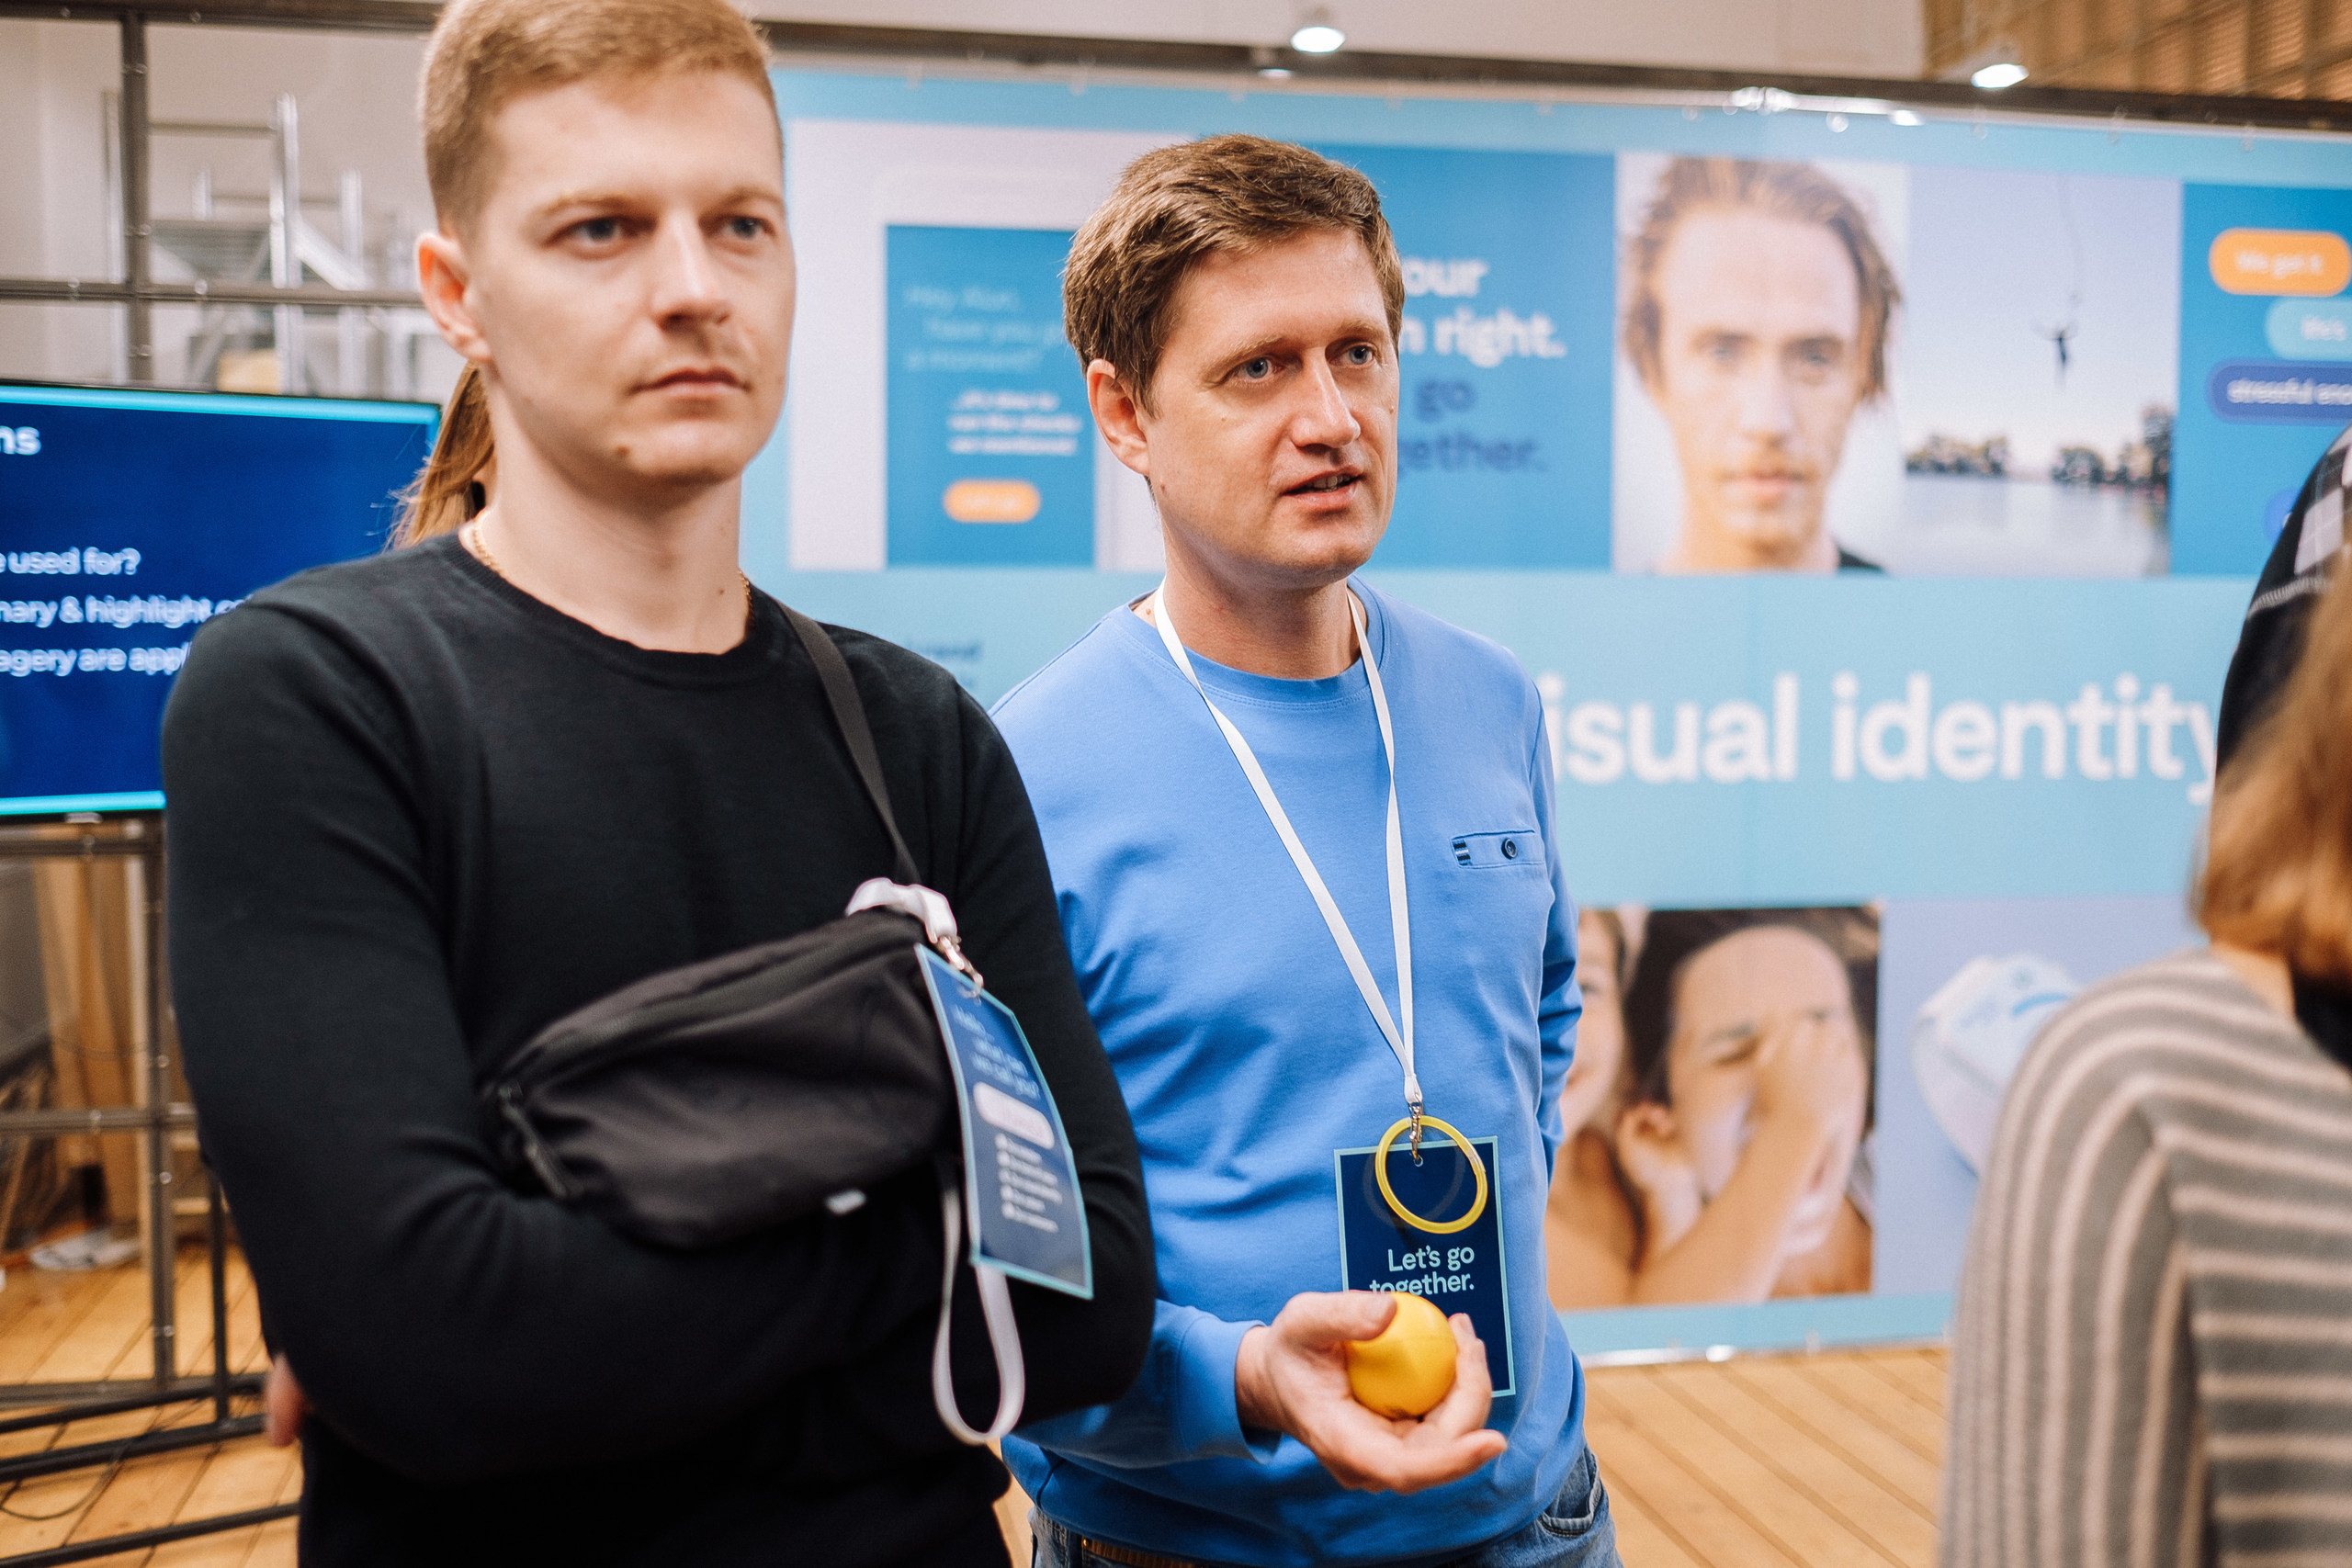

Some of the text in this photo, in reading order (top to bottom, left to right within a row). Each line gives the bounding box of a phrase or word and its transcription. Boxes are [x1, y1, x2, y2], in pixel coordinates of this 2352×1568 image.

[7, 546, 82, 575] used
[84, 547, 141, 576] for?
[59, 595, 85, 624] &
[78, 648, 128, 671] are
[1829, 670, 2215, 807] identity
[1387, 1245, 1475, 1271] Let's go
